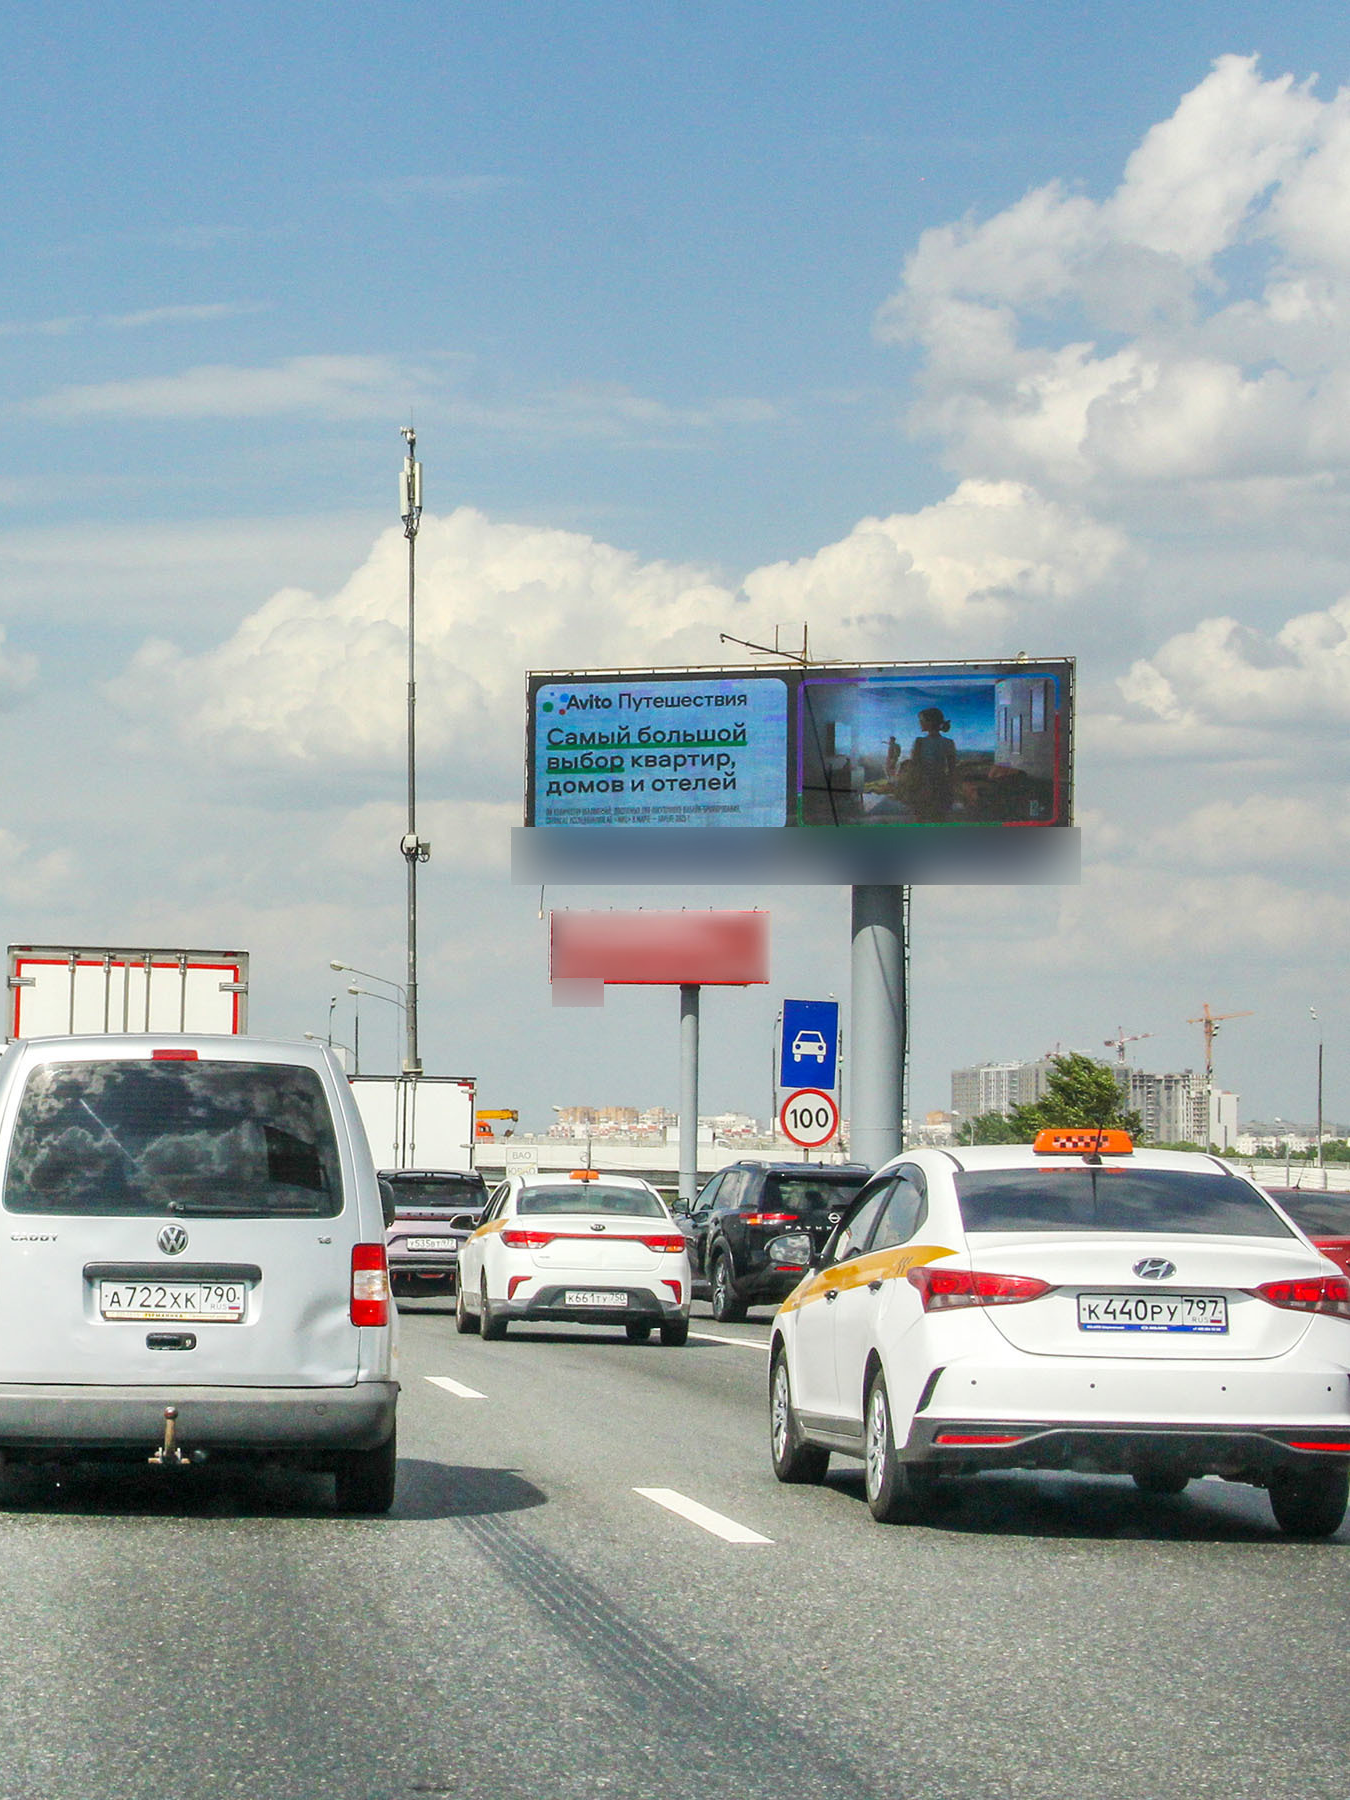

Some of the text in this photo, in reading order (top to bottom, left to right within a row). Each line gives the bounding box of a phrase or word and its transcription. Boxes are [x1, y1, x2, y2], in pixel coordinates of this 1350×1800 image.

[566, 693, 748, 711] Avito Путешествия
[547, 722, 747, 746] Самый большой
[547, 751, 736, 772] выбор квартир,
[546, 771, 737, 797] домов и отелей
[790, 1107, 829, 1129] 100
[10, 1231, 59, 1242] CADDY
[109, 1286, 237, 1309] А722ХК 790
[1087, 1298, 1219, 1321] К440РУ 797
